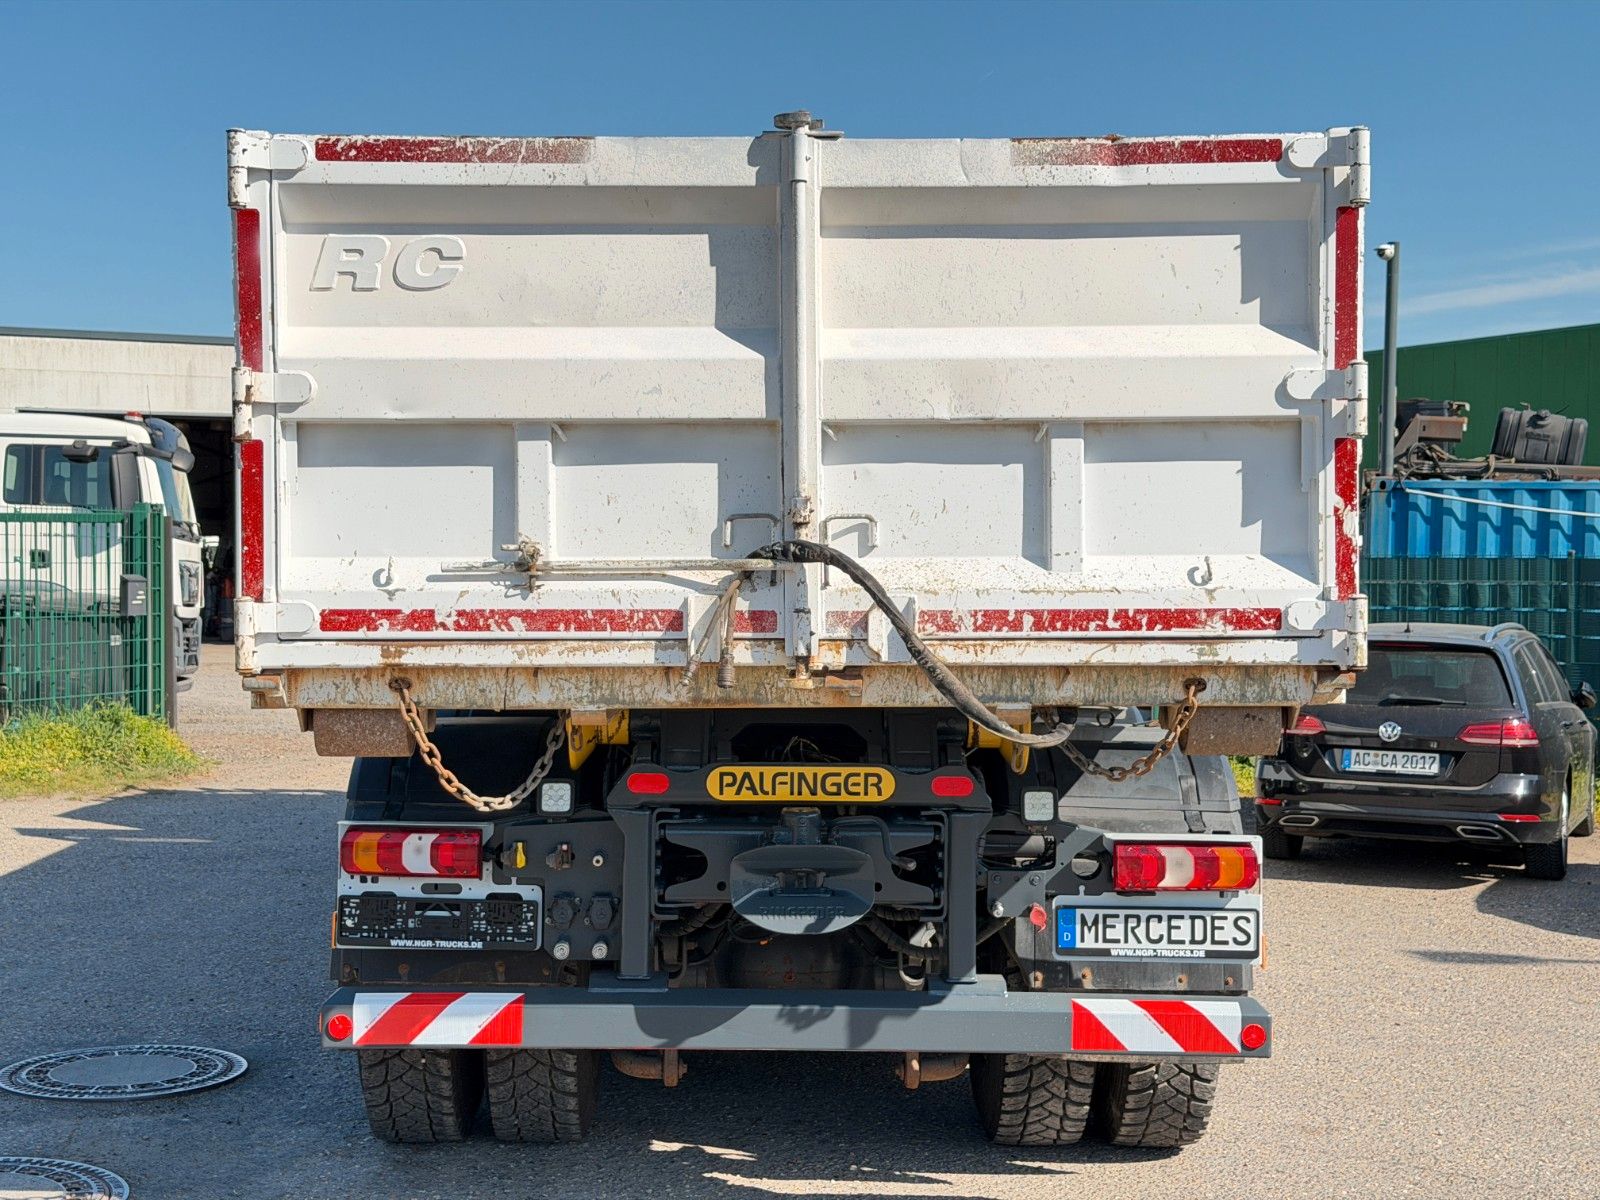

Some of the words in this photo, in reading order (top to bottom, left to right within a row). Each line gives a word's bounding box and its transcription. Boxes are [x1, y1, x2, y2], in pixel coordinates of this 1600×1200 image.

[309, 234, 467, 292] RC
[1353, 752, 1371, 767] AC
[1380, 753, 1398, 768] CA
[1402, 754, 1436, 770] 2017
[718, 771, 883, 797] PALFINGER
[1063, 932, 1071, 941] D
[1080, 913, 1251, 946] MERCEDES
[390, 939, 483, 949] WWW.NGR-TRUCKS.DE
[1110, 948, 1206, 958] WWW.NGR-TRUCKS.DE
